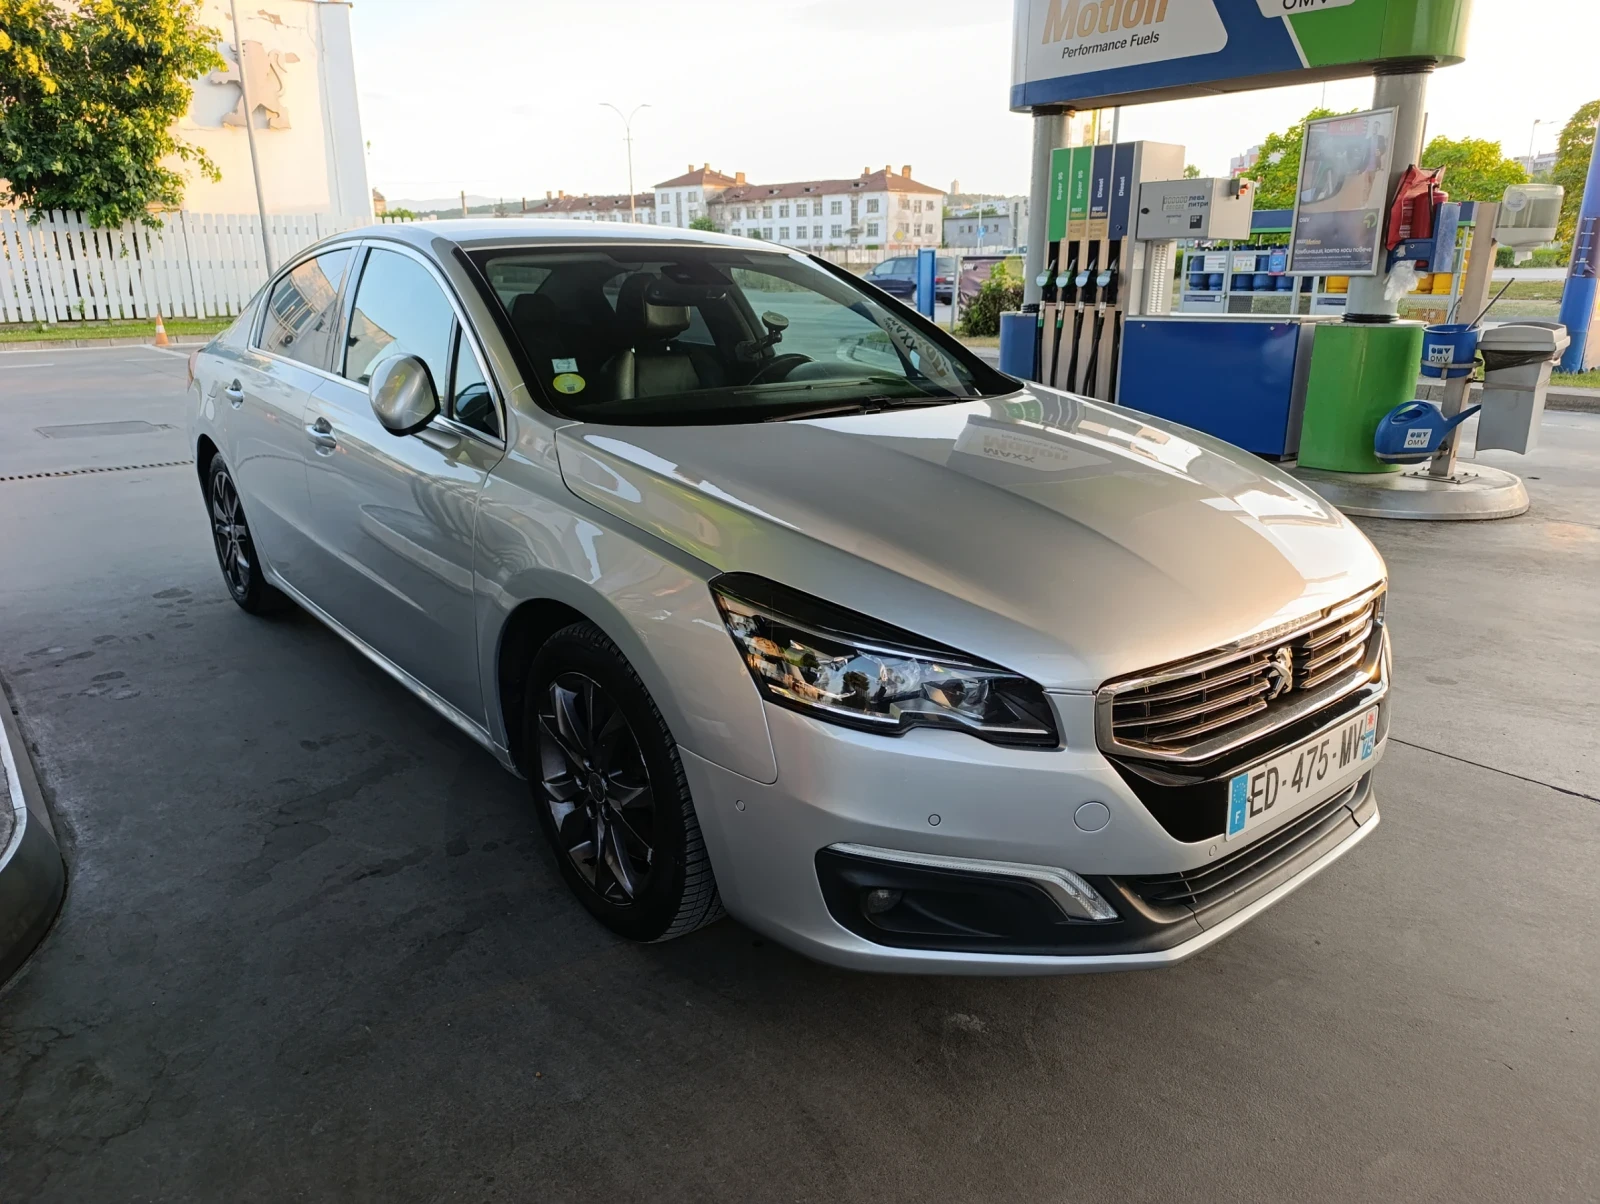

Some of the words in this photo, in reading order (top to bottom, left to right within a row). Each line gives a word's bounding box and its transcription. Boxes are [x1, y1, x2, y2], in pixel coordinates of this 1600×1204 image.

[1042, 0, 1168, 45] Motion
[1062, 39, 1127, 59] Performance
[1129, 31, 1160, 47] Fuels
[1234, 810, 1242, 825] F
[1363, 739, 1373, 754] 75
